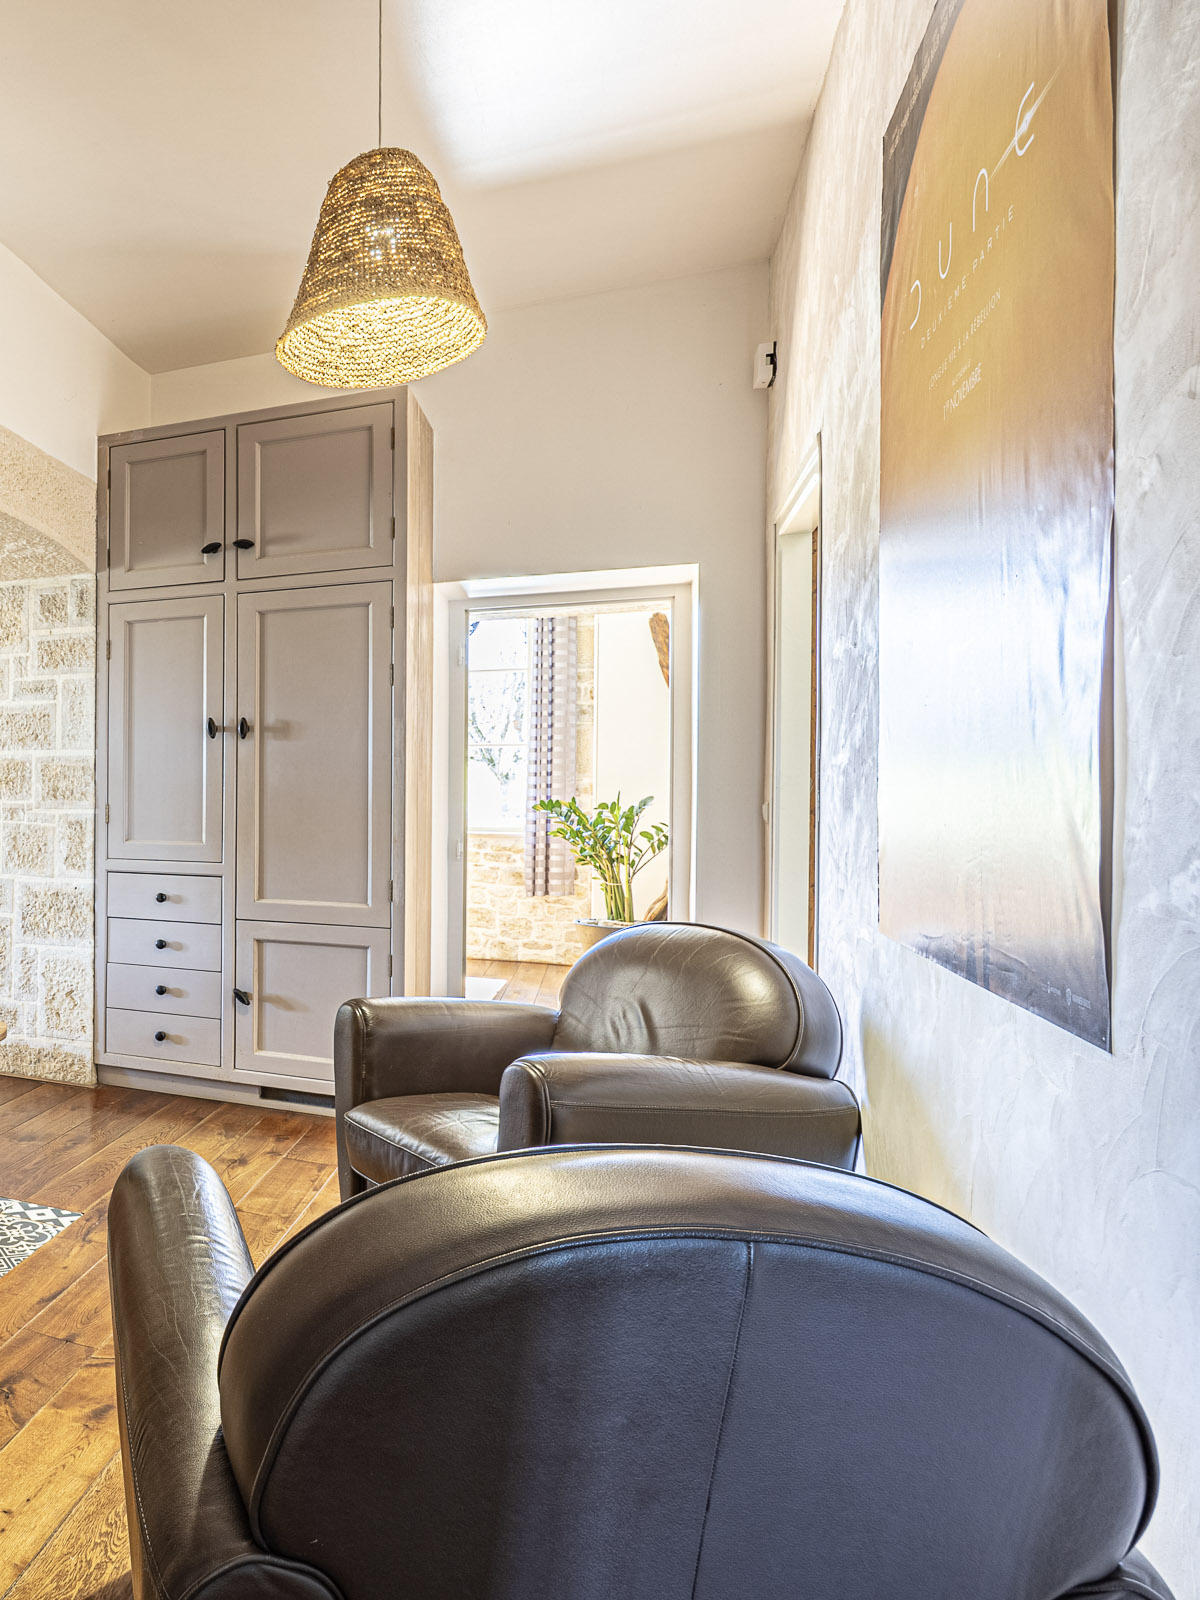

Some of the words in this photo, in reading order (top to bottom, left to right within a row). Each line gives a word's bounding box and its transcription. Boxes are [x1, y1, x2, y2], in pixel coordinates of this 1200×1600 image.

[921, 275, 967, 349] DEUXIÈME
[972, 205, 1014, 274] PARTIE
[970, 288, 1001, 335] RÉBELLION
